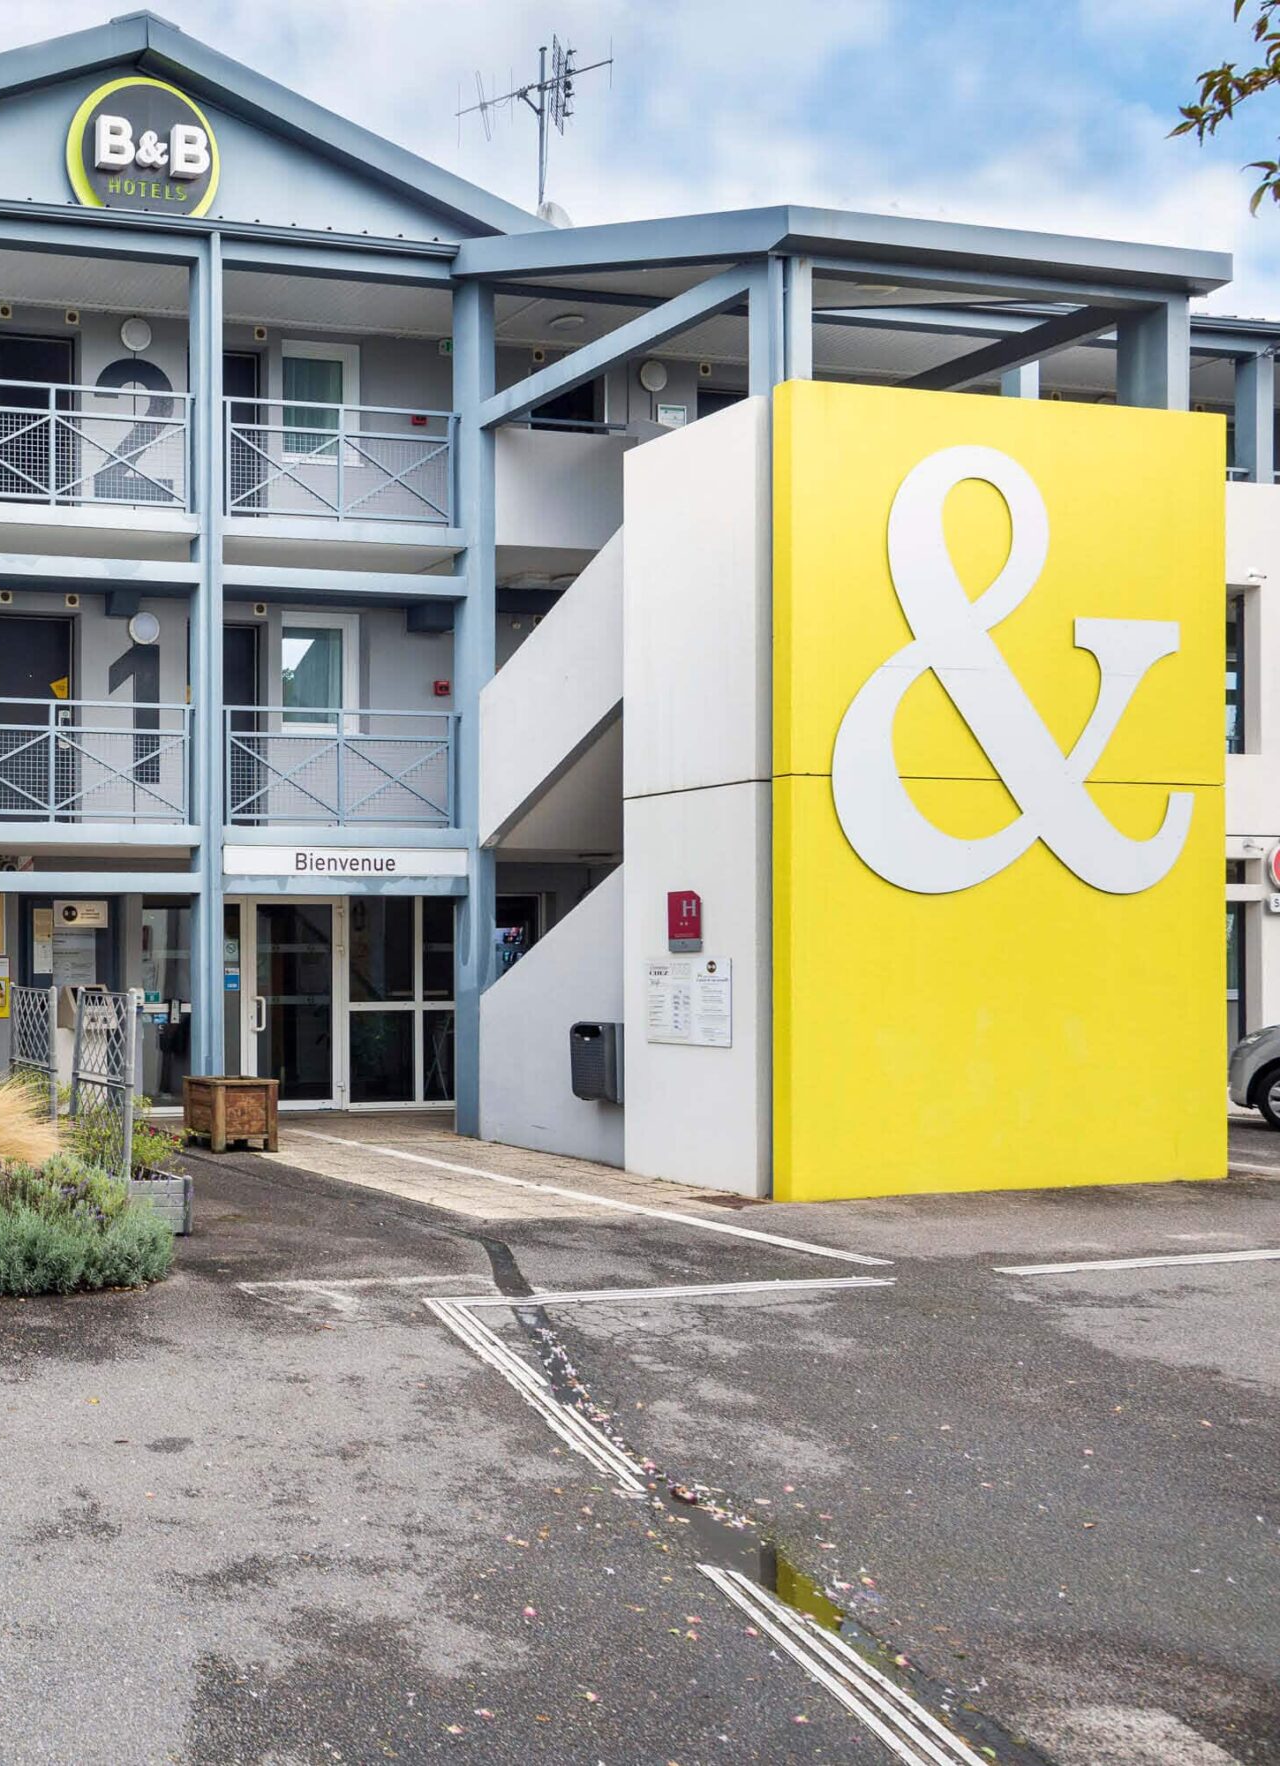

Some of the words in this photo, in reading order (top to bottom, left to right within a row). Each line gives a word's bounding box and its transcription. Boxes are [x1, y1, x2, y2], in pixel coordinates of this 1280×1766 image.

[95, 114, 210, 178] B&B
[108, 176, 187, 201] HOTELS
[94, 358, 174, 502] 2
[831, 444, 1195, 894] &
[108, 644, 160, 784] 1
[295, 852, 396, 872] Bienvenue
[682, 899, 697, 917] H
